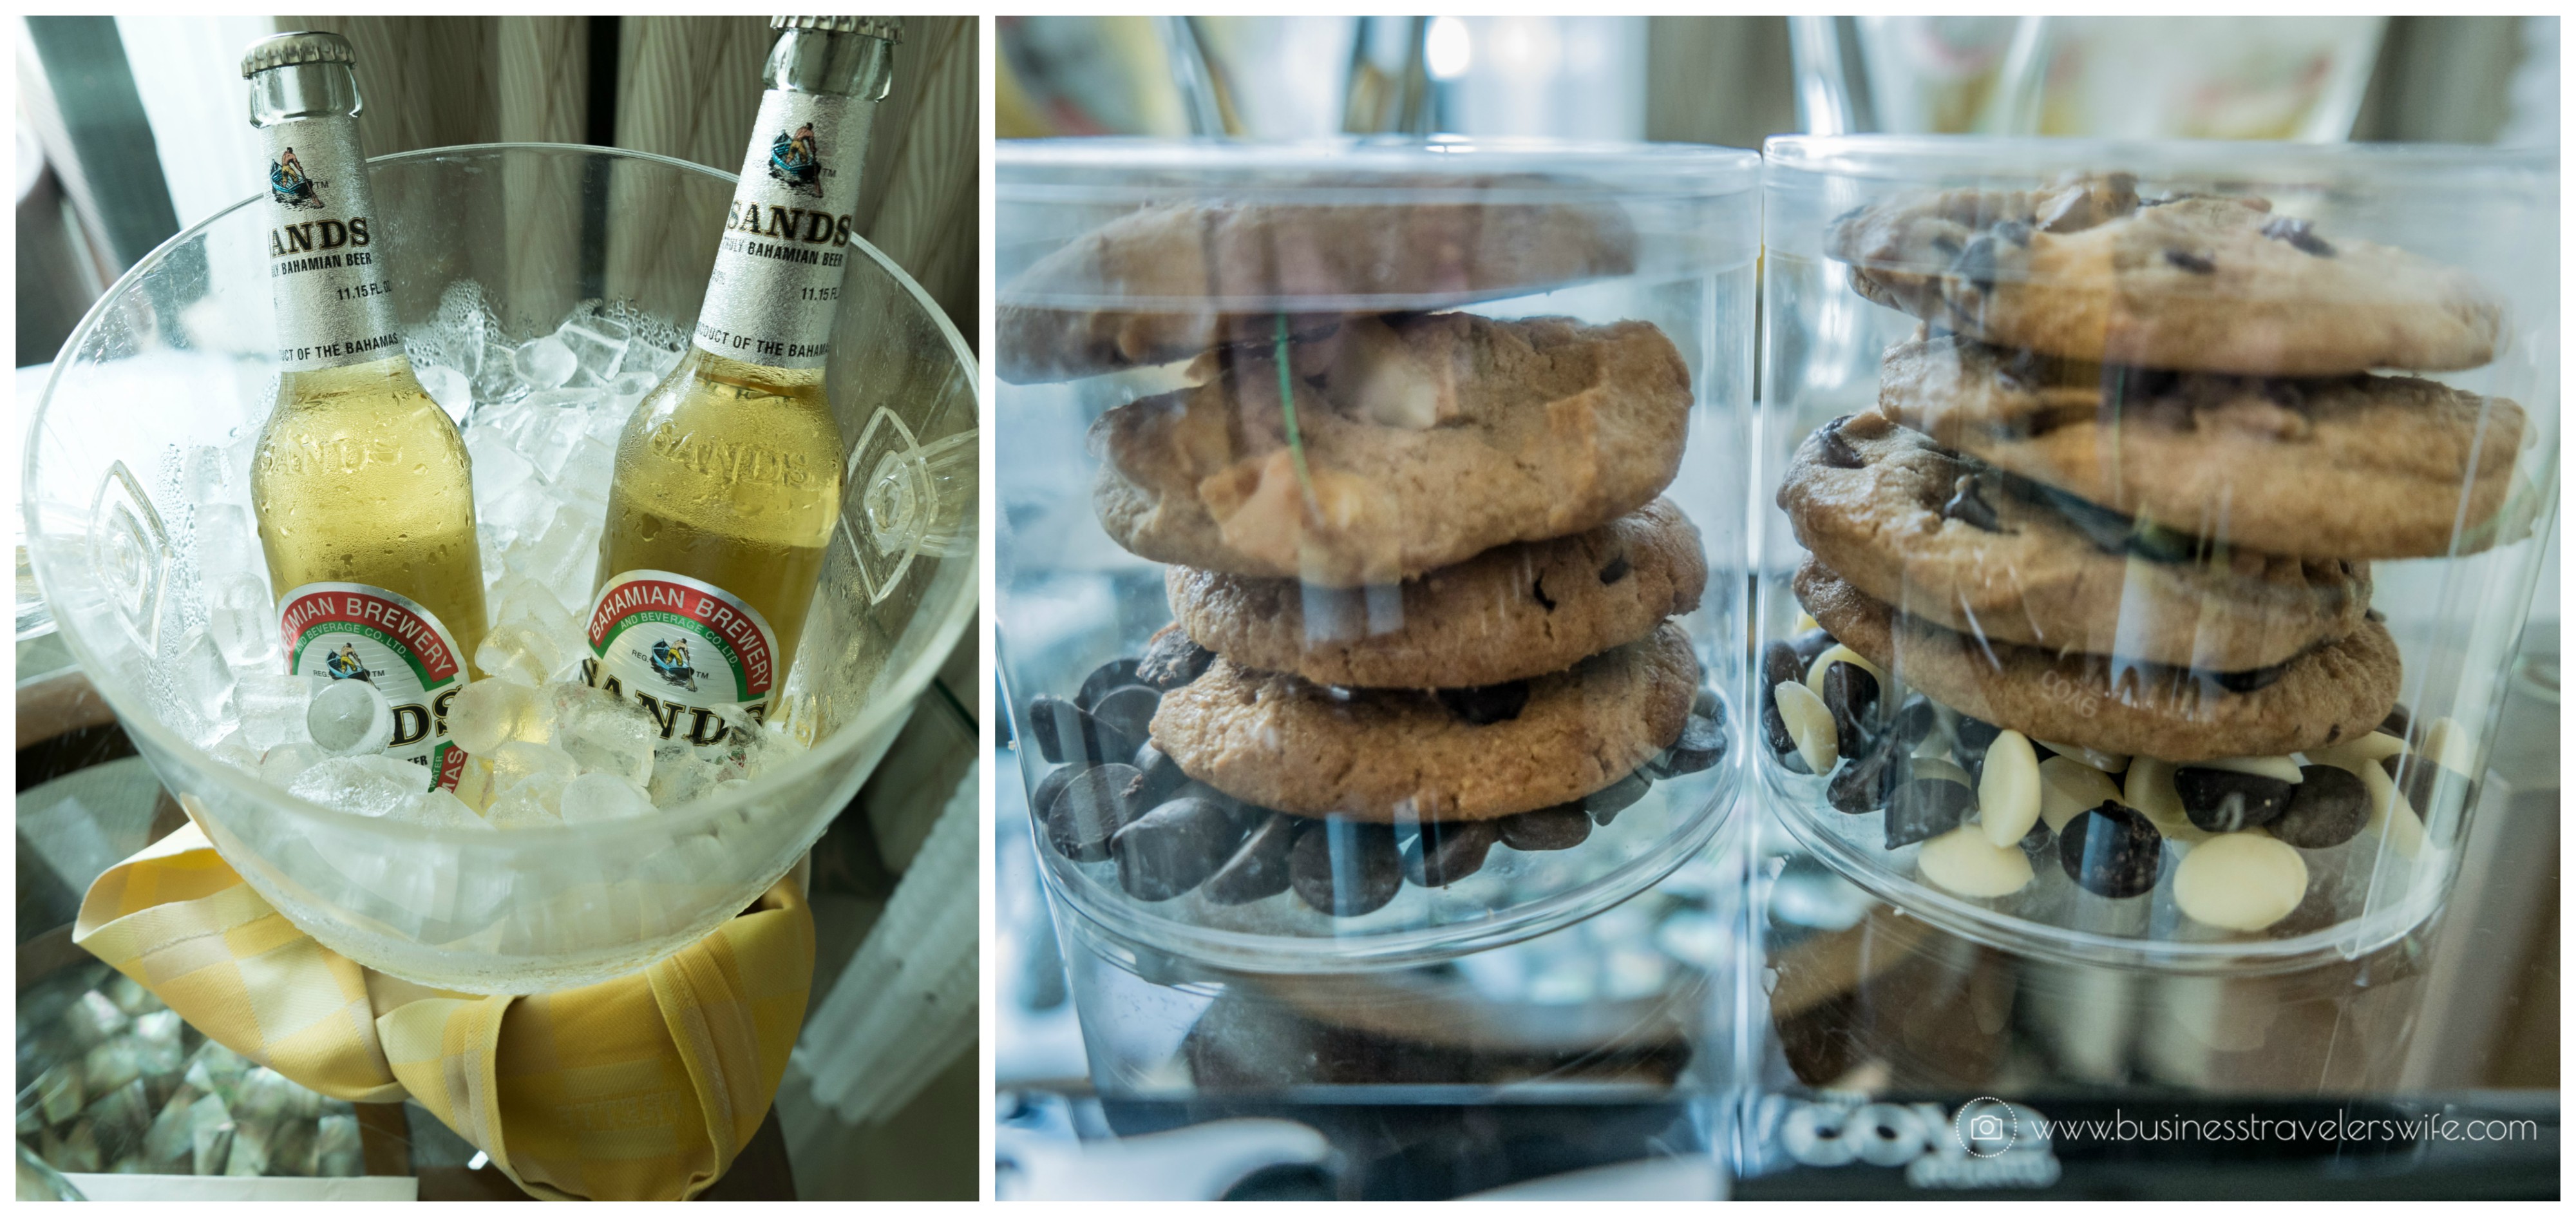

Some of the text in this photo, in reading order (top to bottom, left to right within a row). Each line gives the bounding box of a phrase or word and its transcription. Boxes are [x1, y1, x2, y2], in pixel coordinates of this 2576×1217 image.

[822, 168, 837, 177] TM
[728, 200, 853, 247] SANDS
[268, 217, 371, 258] ANDS
[281, 255, 341, 274] BAHAMIAN
[346, 253, 372, 266] BEER
[748, 242, 819, 265] BAHAMIAN
[822, 252, 844, 267] BEER
[337, 285, 368, 300] 11.15
[802, 287, 829, 301] 11.15
[297, 348, 310, 361] OF
[315, 344, 341, 358] THE
[346, 332, 399, 354] BAHAMAS
[733, 335, 752, 350] OF
[757, 340, 784, 356] THE
[307, 622, 361, 639] BEVERAGE
[620, 614, 638, 630] AND
[641, 612, 703, 634] BEVERAGE
[346, 597, 452, 675] BREWERY
[591, 586, 769, 688] BAHAMIAN BREWERY
[430, 755, 443, 787] WATER
